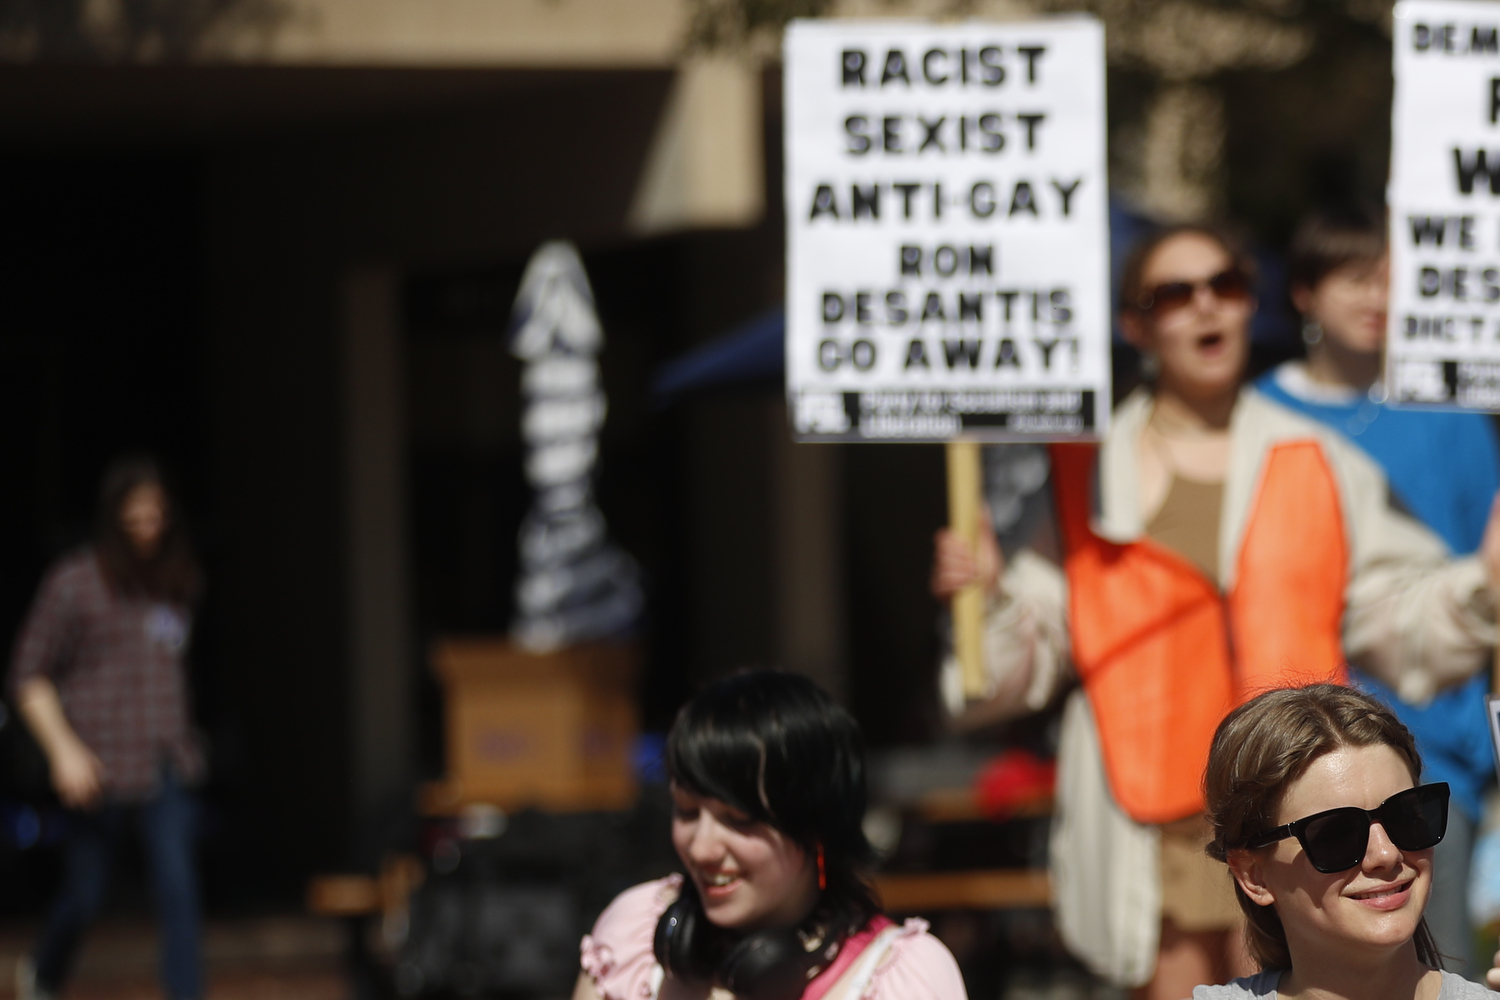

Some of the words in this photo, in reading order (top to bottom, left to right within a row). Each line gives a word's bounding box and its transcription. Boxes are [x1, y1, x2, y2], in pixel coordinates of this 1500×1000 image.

[839, 46, 1046, 88] RACIST
[843, 113, 1046, 156] SEXIST
[809, 179, 1081, 220] ANTI-GAY
[1409, 216, 1475, 248] WE
[899, 245, 994, 277] RON
[822, 290, 1074, 325] DESANTIS
[817, 338, 877, 373] GO
[904, 337, 1079, 374] AWAY!
